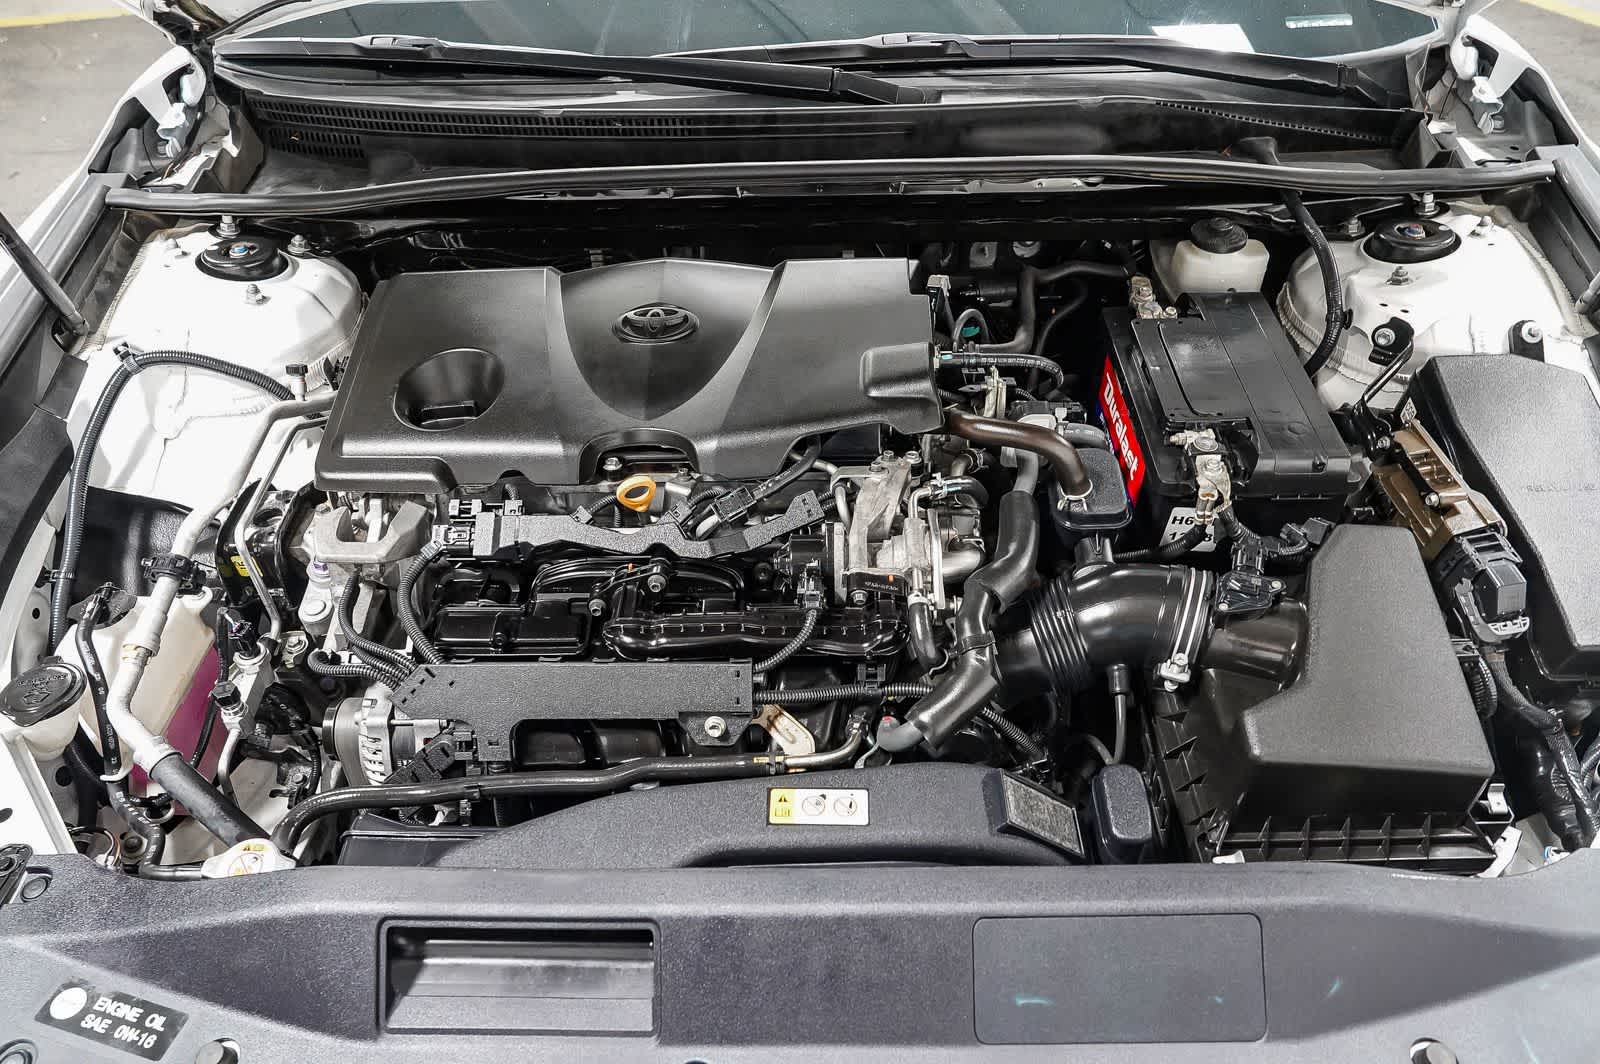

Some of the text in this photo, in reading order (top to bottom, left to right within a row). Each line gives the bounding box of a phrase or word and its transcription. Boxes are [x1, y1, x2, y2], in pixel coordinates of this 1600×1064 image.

[1104, 372, 1138, 481] Duralast
[80, 1013, 157, 1049] SAE 0W-16
[94, 997, 167, 1032] ENGINE OIL
